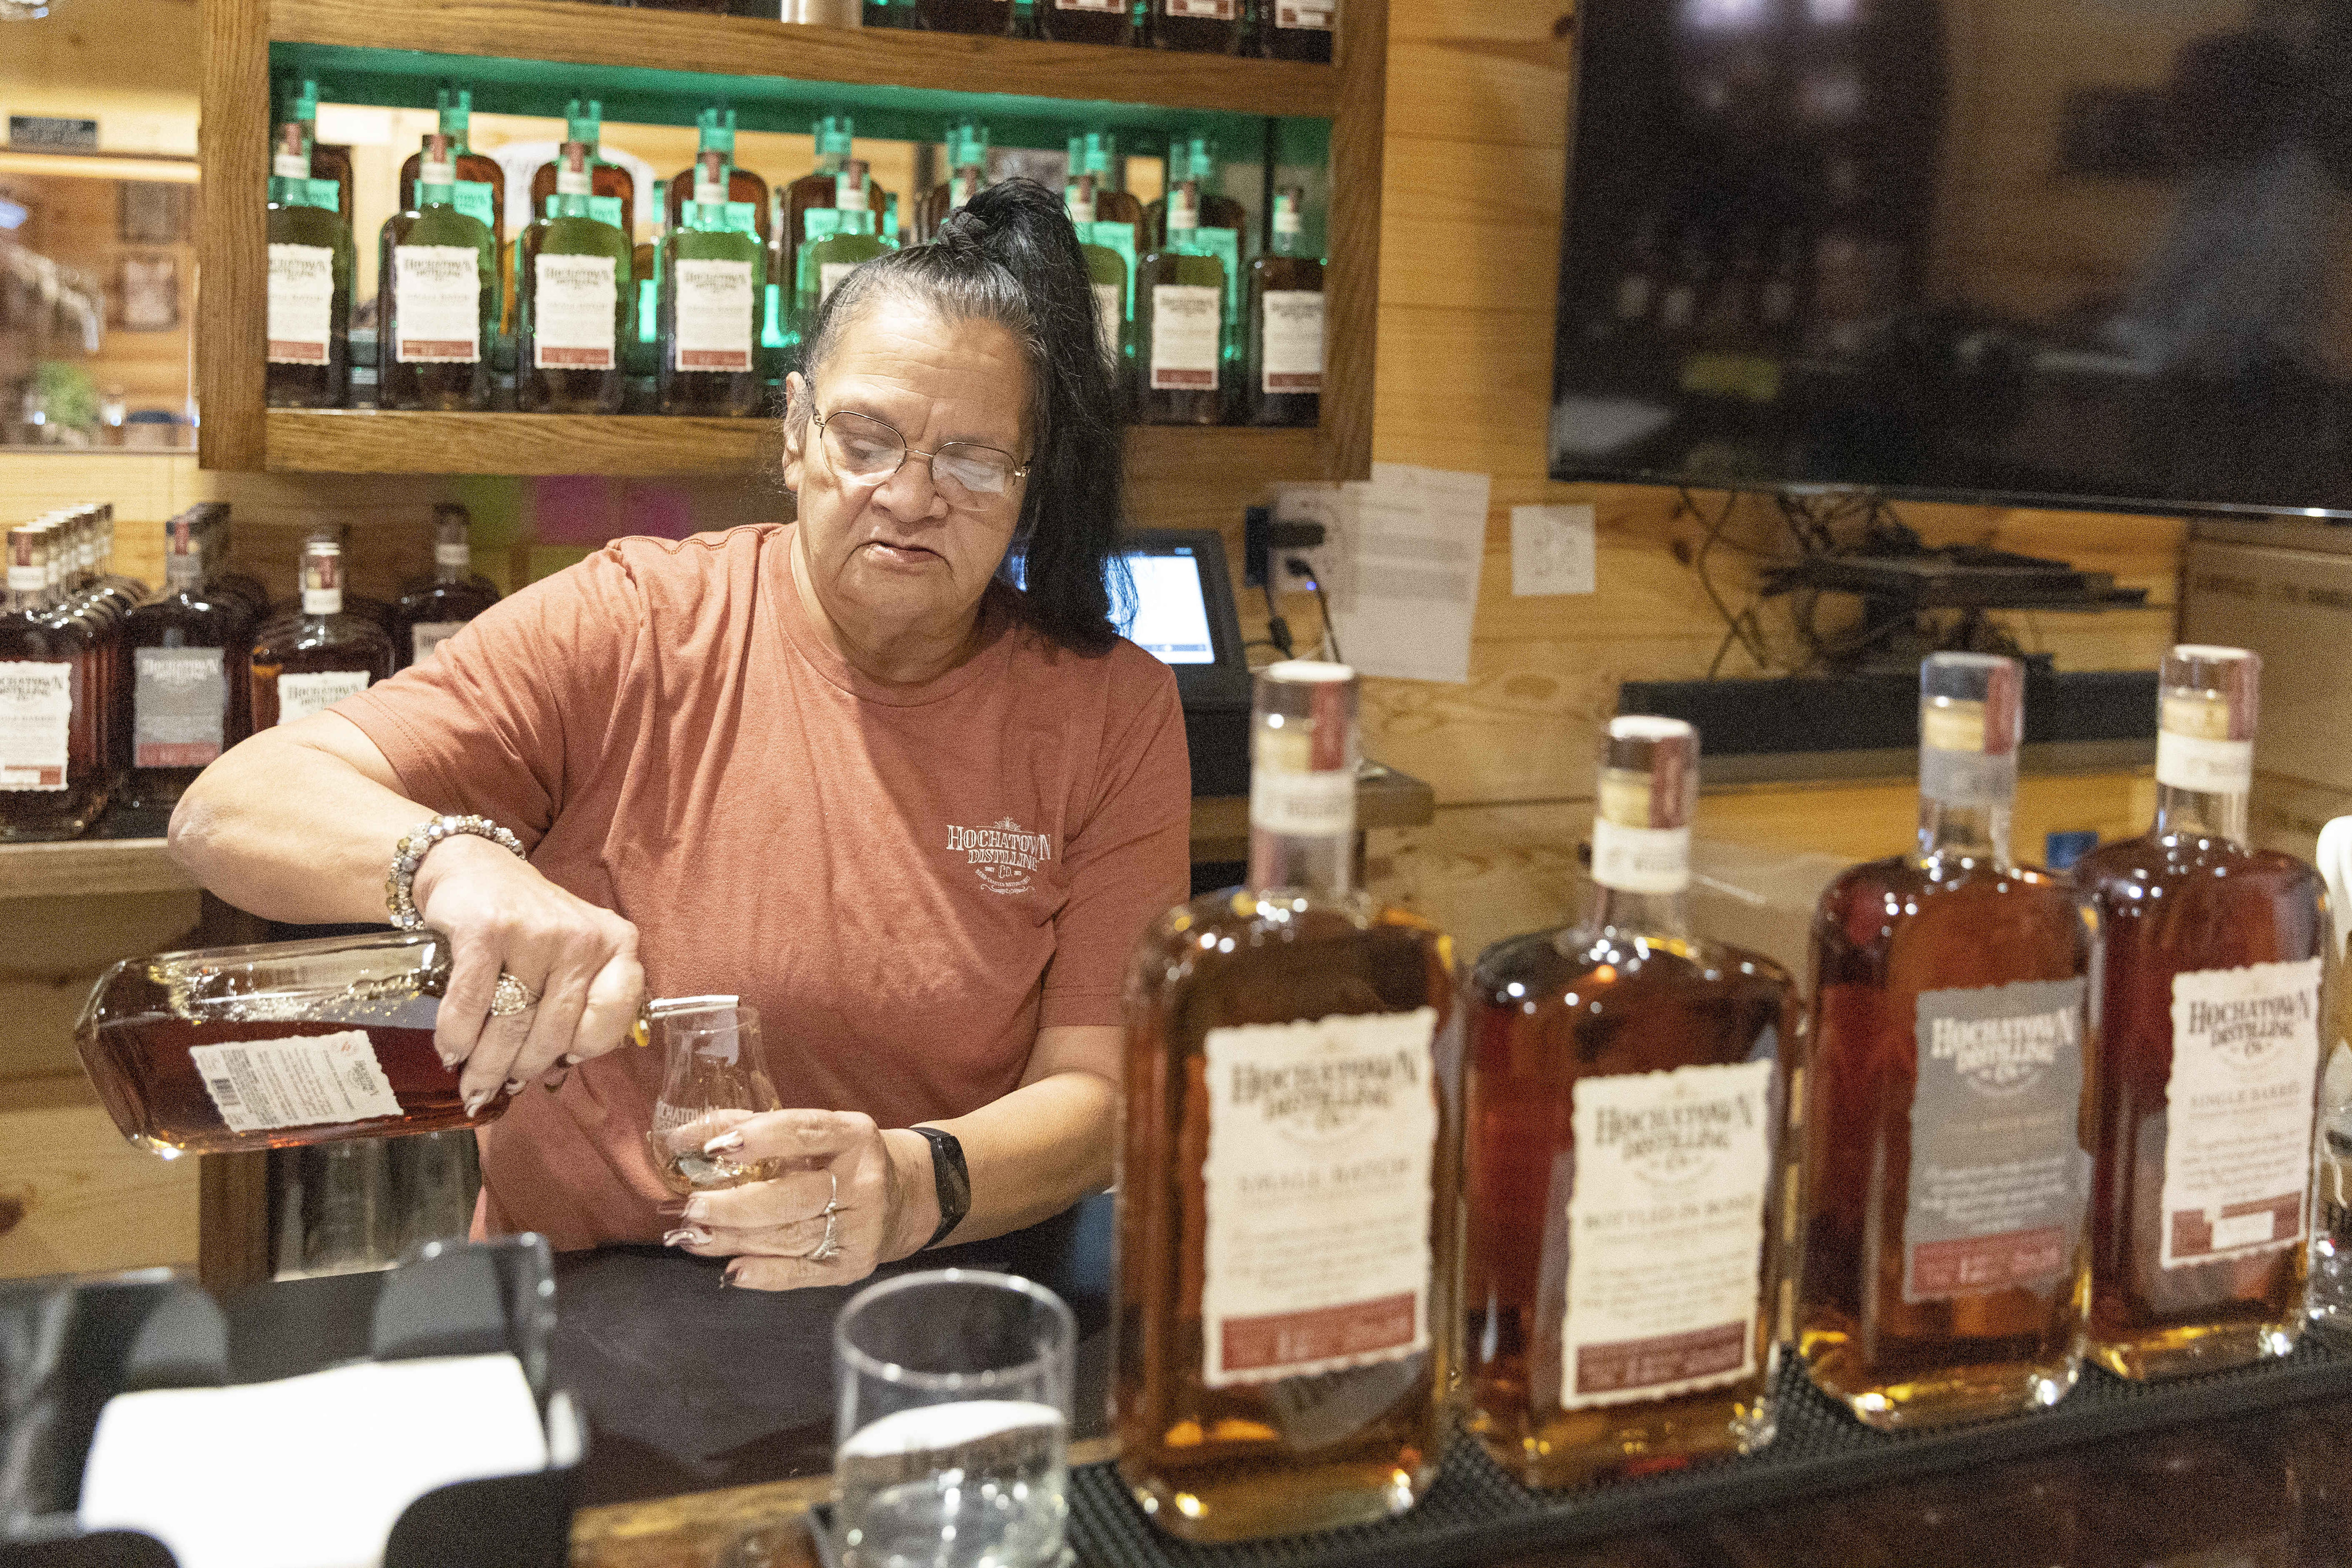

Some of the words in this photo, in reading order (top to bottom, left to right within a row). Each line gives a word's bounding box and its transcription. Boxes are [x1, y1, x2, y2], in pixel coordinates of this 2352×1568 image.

[946, 825, 1051, 860] HOCHATOWN
[967, 849, 1039, 872] DISTILLING
[2187, 990, 2310, 1036] HOCHATOWN
